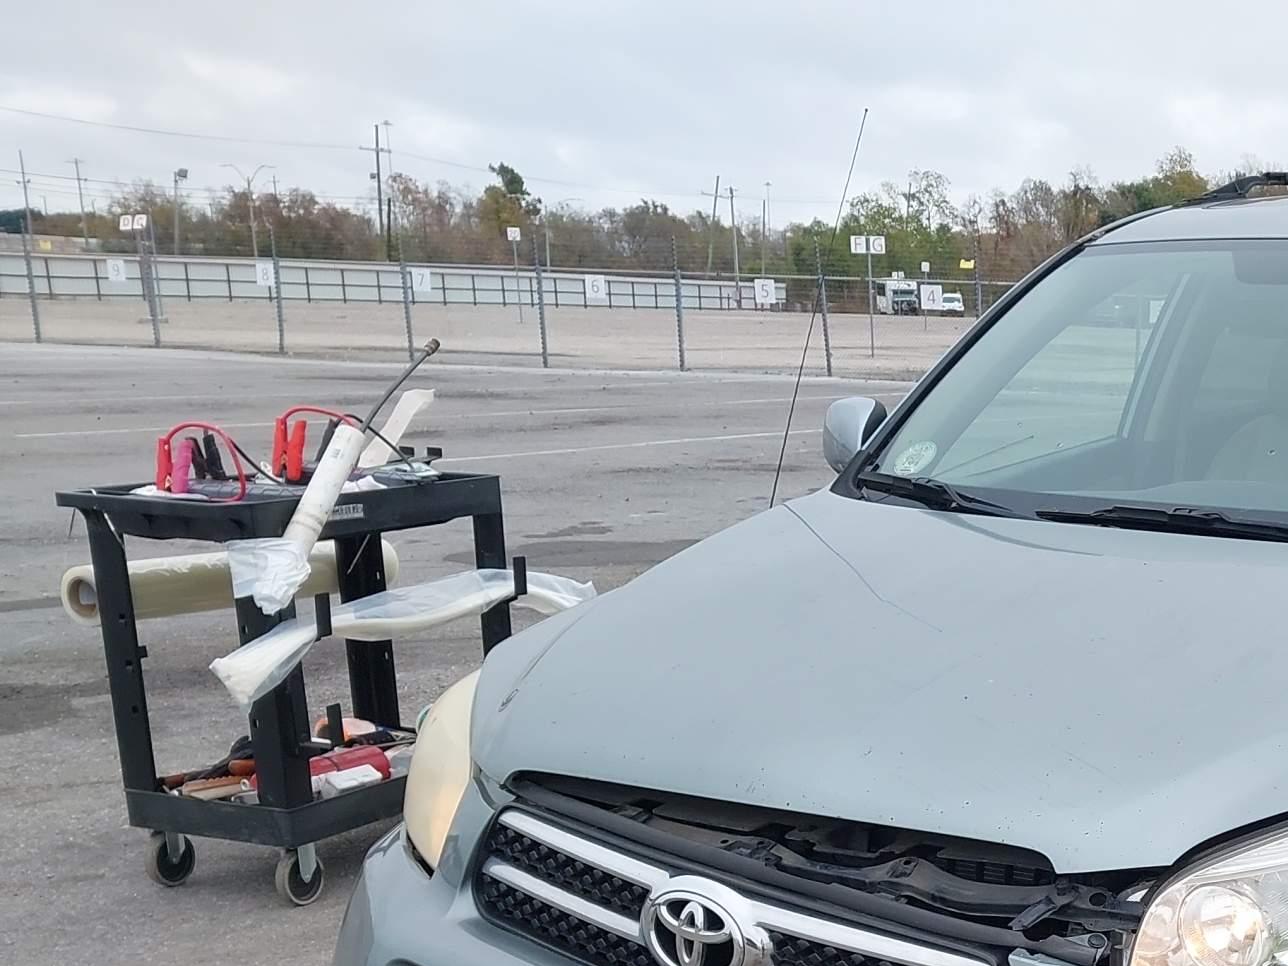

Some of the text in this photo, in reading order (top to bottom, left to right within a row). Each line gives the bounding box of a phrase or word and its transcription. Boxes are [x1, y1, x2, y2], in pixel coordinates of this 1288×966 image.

[854, 237, 883, 252] F G
[112, 263, 120, 276] 9
[262, 268, 269, 281] 8
[417, 272, 424, 287] 7
[591, 279, 600, 293] 6
[761, 283, 769, 298] 5
[927, 290, 936, 304] 4
